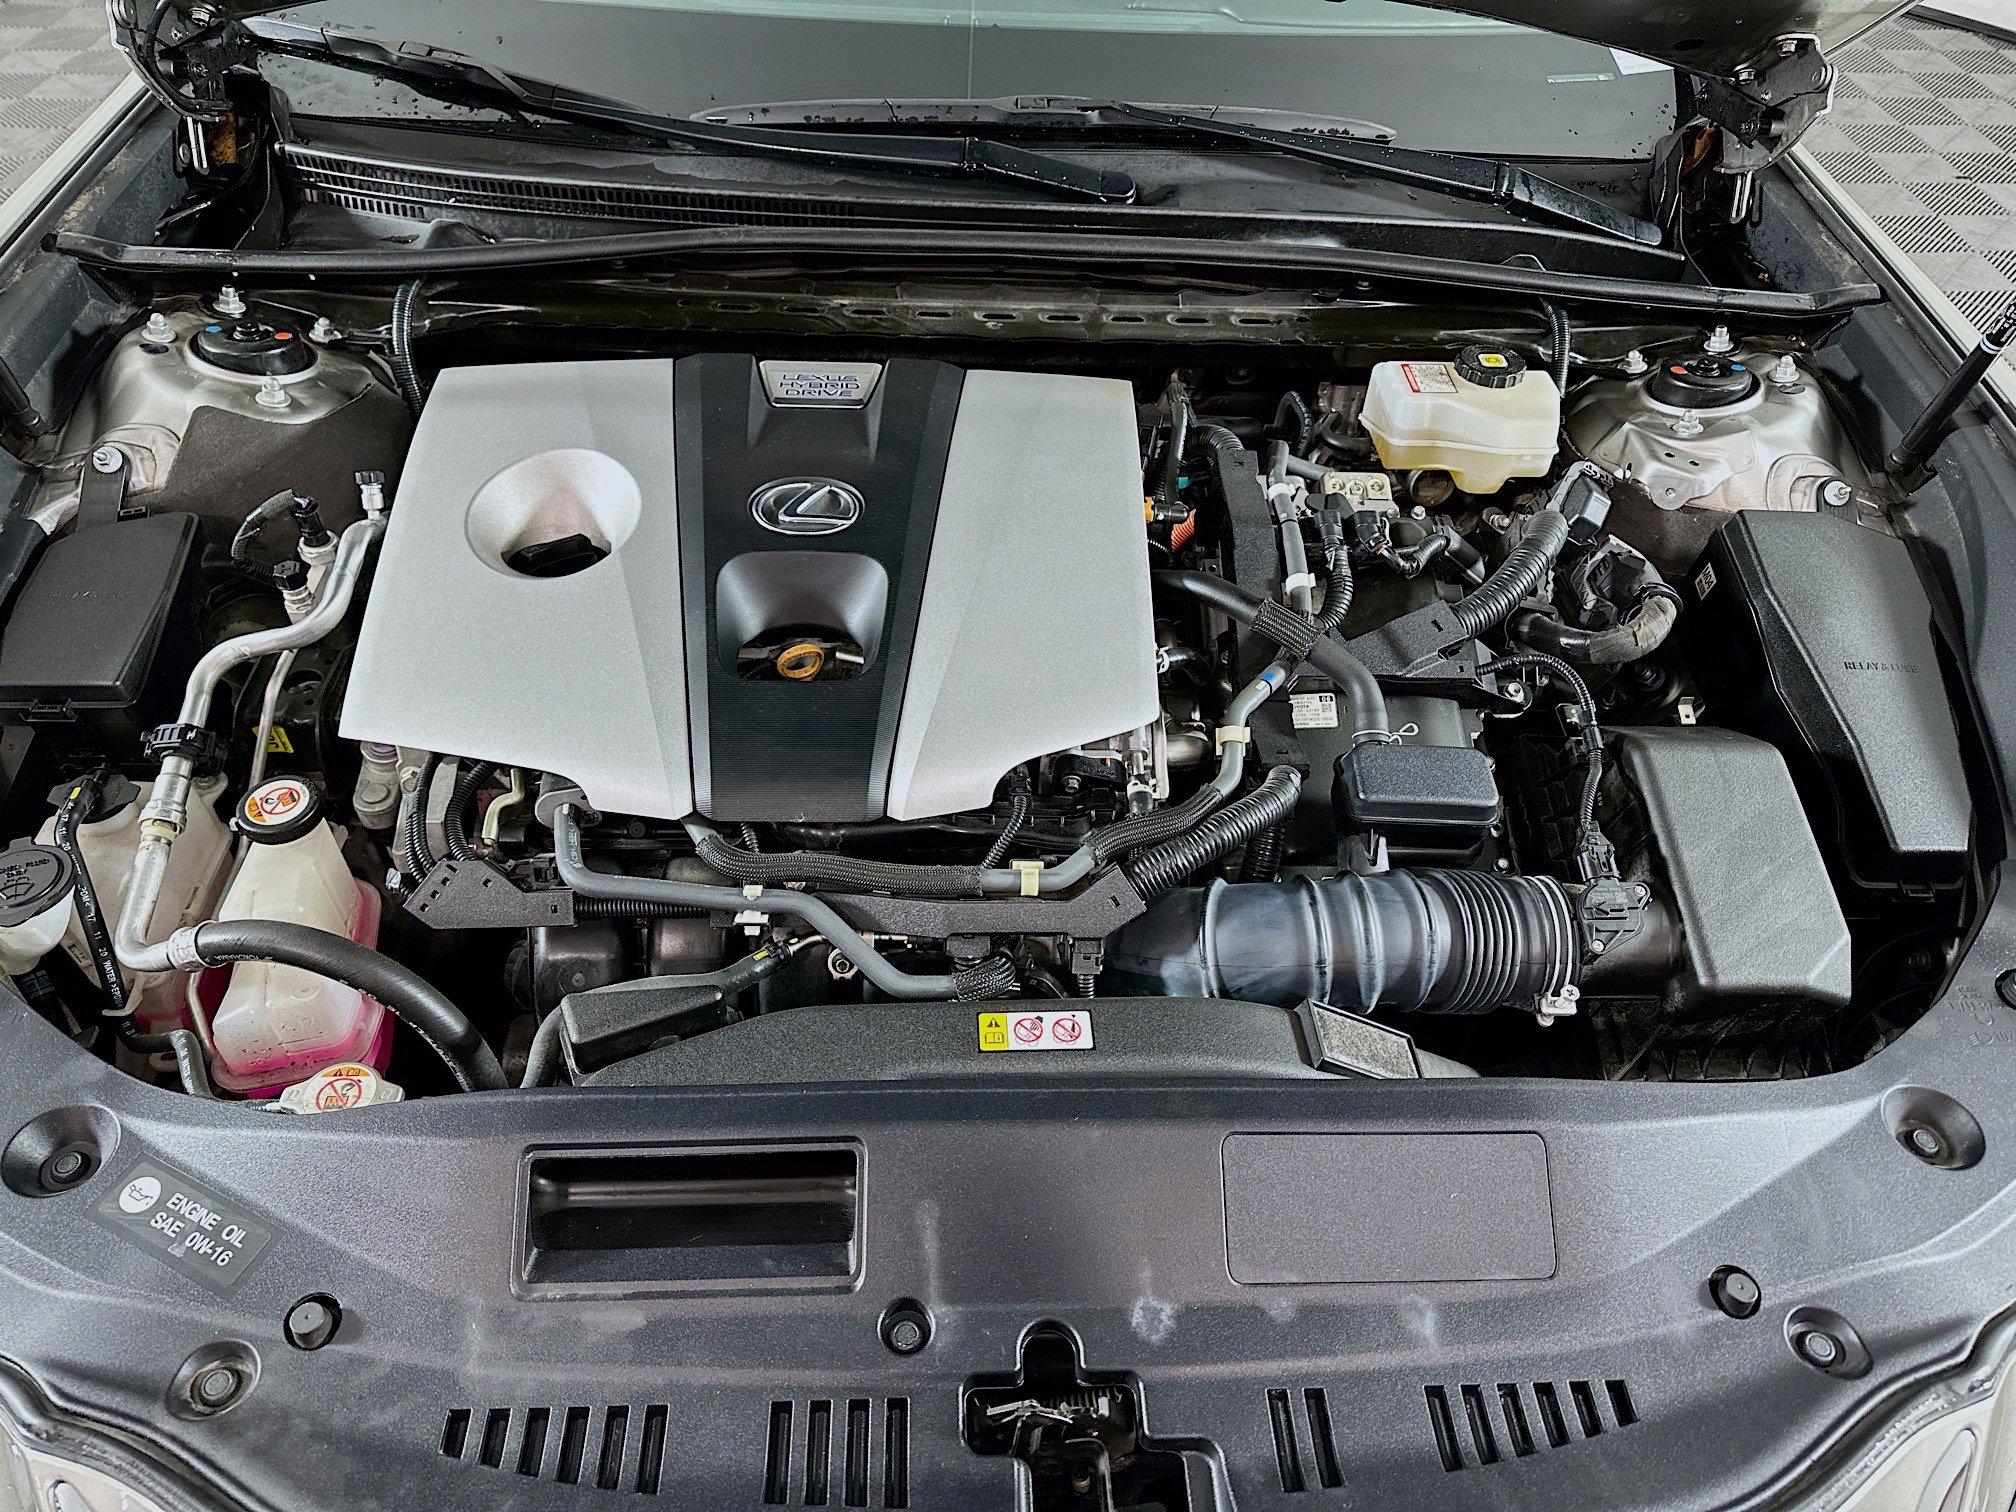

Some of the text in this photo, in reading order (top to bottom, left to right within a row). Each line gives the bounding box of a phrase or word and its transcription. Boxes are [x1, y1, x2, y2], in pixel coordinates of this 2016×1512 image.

[782, 373, 858, 382] LEXUS
[779, 381, 860, 390] HYBRID
[785, 388, 853, 397] DRIVE
[1843, 661, 1879, 671] RELAY
[94, 931, 103, 940] 11
[98, 947, 109, 957] 20
[102, 959, 117, 984] WATER
[165, 1192, 247, 1249] ENGINE OIL
[150, 1211, 234, 1267] SAE 0W-16
